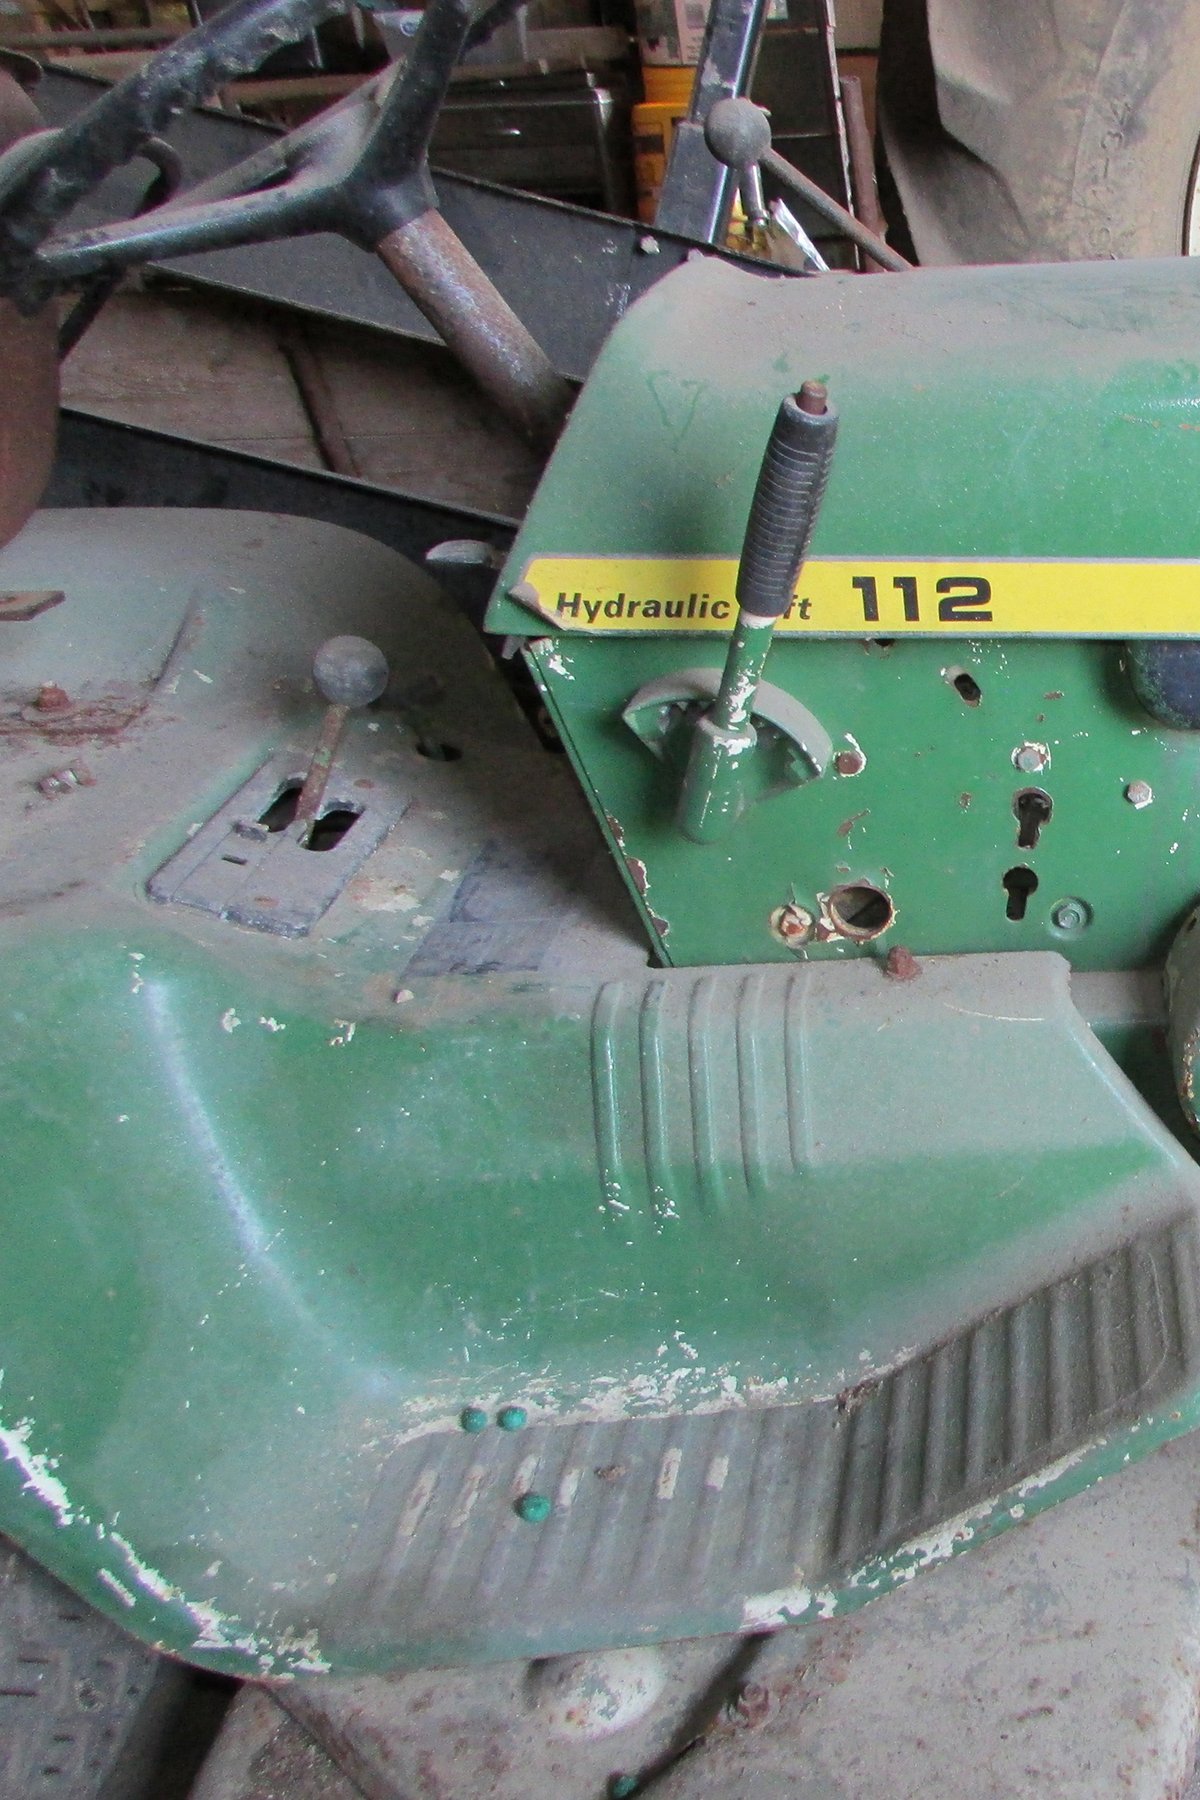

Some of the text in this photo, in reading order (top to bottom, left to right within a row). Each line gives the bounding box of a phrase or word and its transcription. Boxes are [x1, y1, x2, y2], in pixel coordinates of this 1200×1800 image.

[556, 576, 993, 624] Hydraulic ft 112
